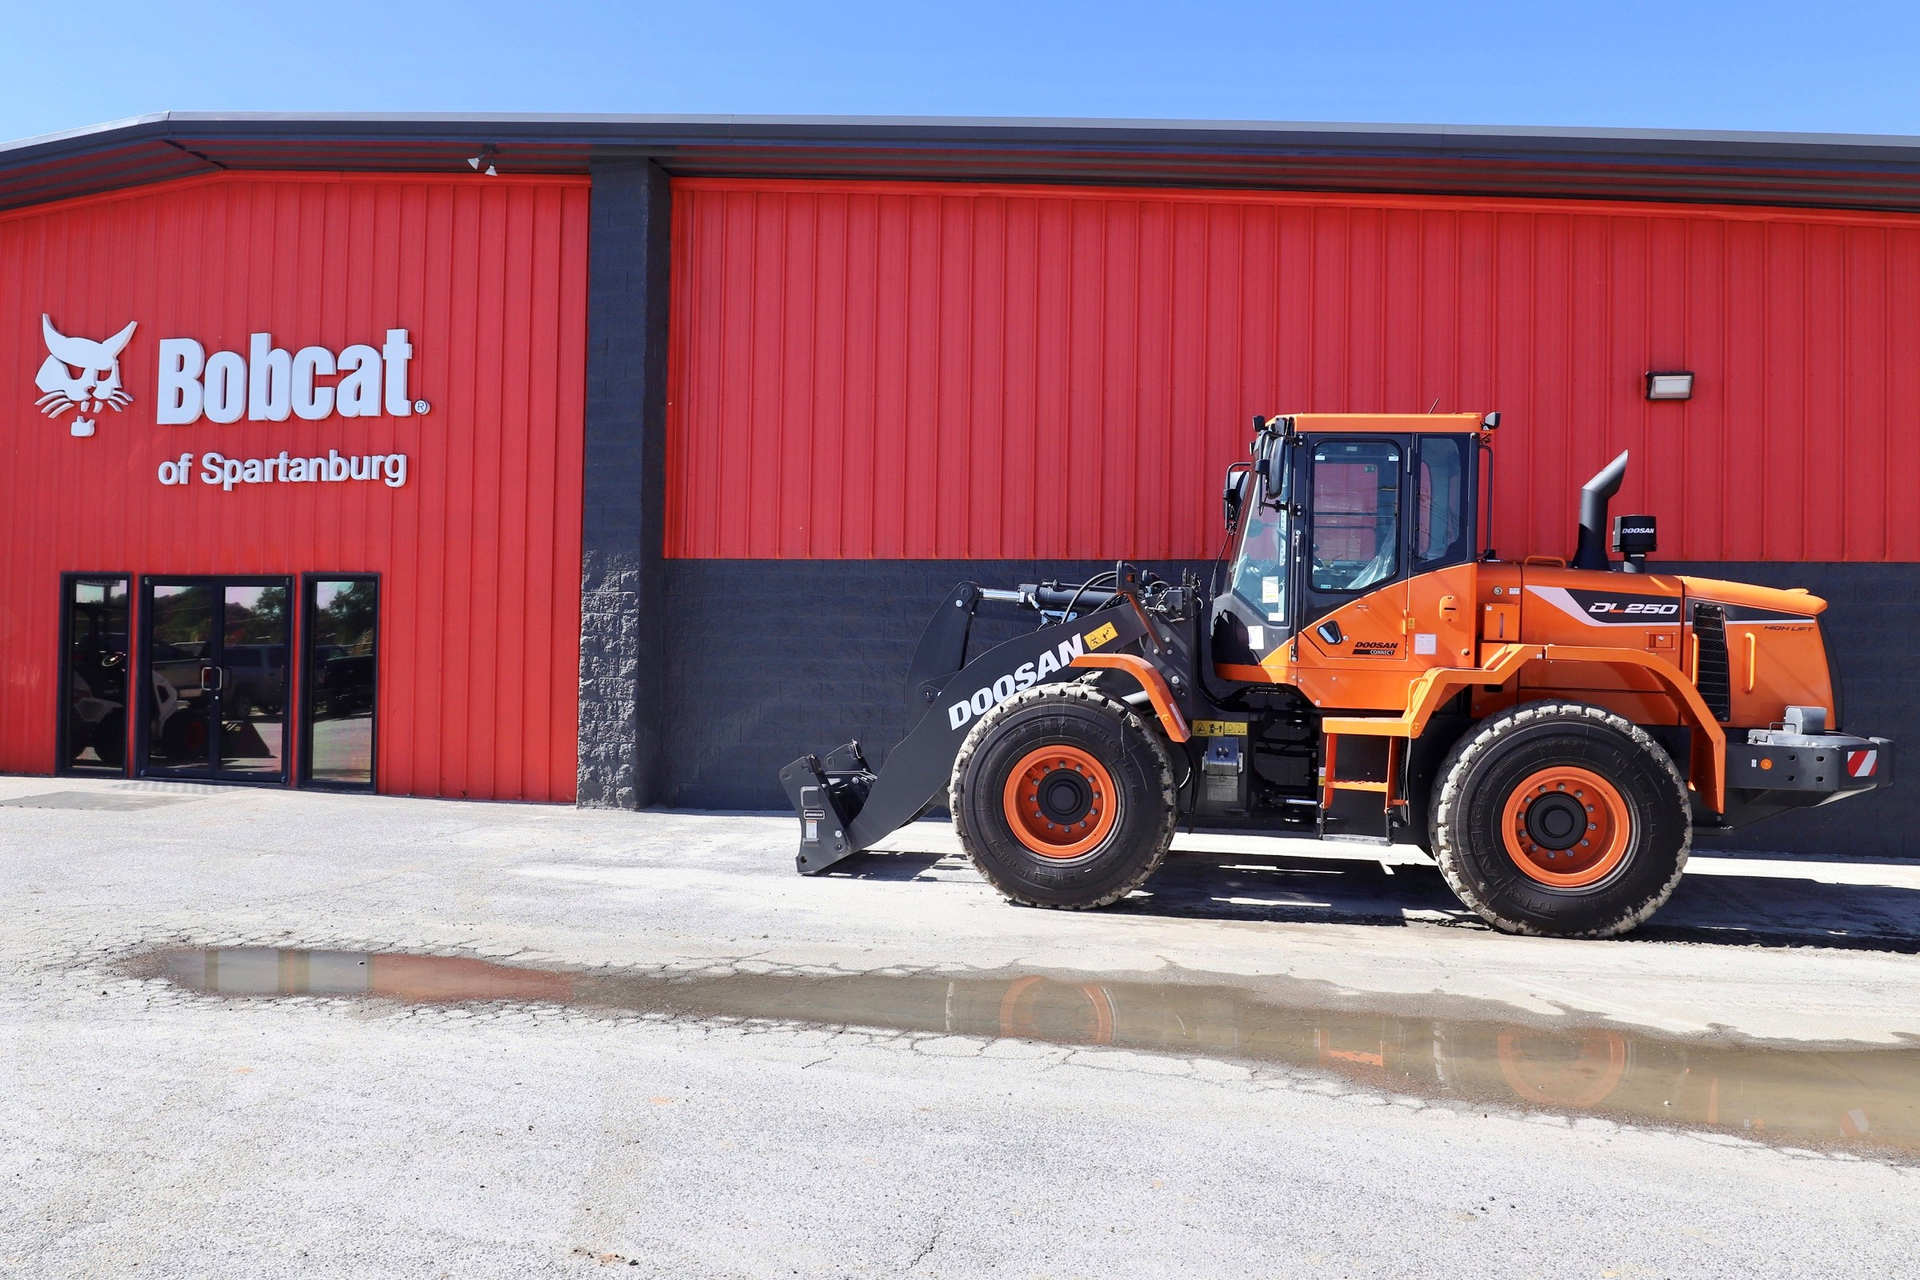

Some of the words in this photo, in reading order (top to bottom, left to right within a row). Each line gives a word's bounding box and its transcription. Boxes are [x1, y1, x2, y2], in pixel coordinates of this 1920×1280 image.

[157, 329, 412, 425] Bobcat
[158, 453, 193, 485] of
[201, 449, 407, 491] Spartanburg
[1588, 602, 1679, 615] DL250
[1354, 641, 1398, 649] DOOSAN
[948, 633, 1085, 731] DOOSAN
